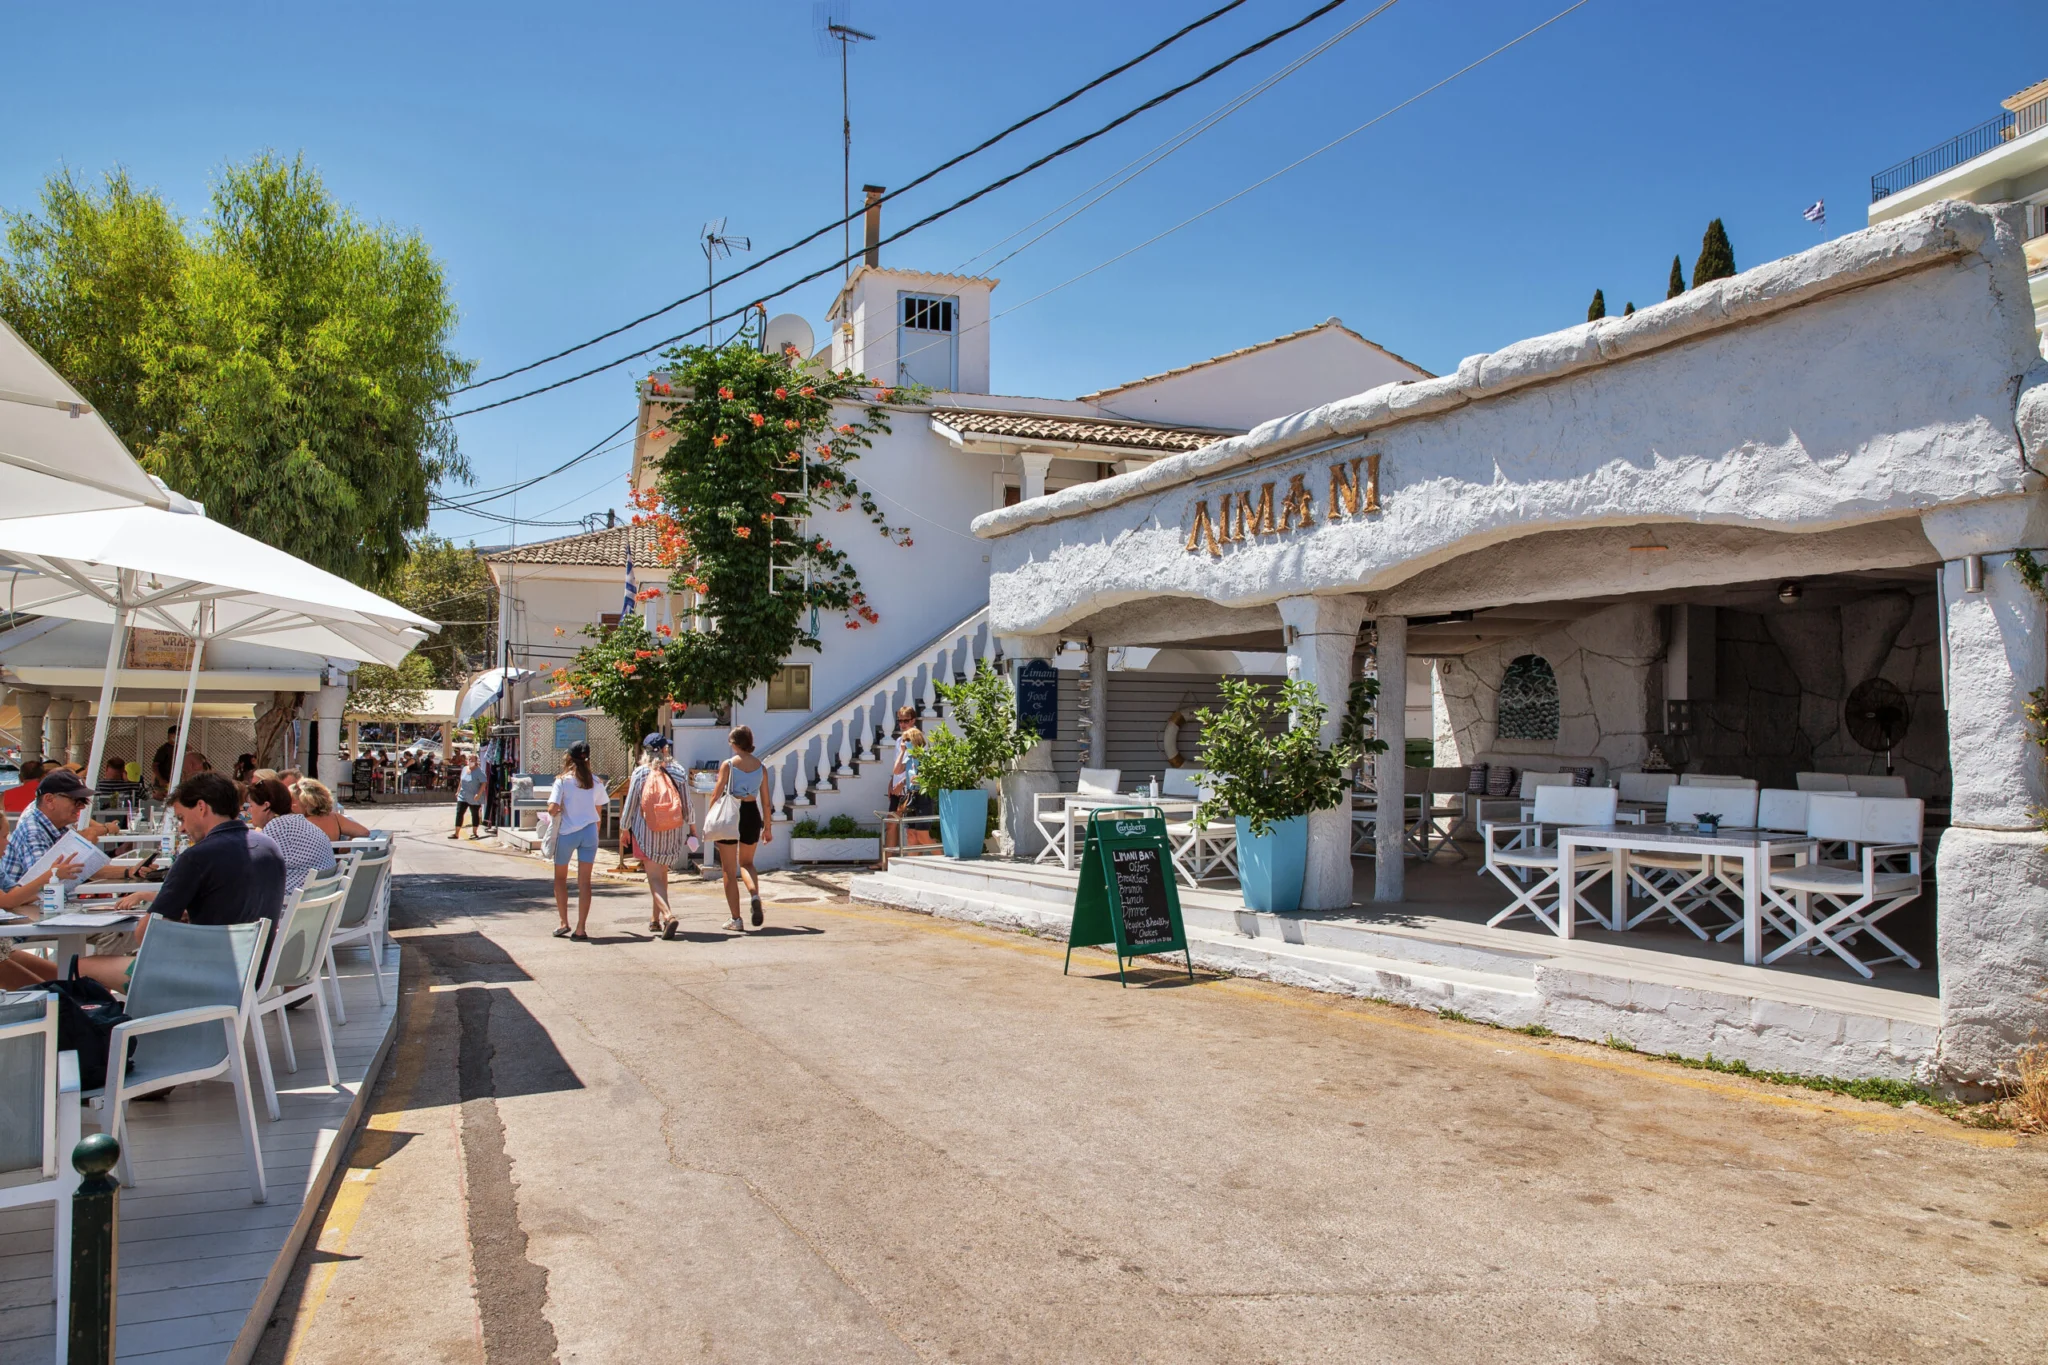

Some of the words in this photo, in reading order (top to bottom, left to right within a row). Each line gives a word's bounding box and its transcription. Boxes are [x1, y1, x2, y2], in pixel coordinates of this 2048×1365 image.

[1021, 667, 1056, 678] Limani
[1027, 691, 1049, 702] Food
[1116, 820, 1147, 836] Carlsberg
[1112, 851, 1137, 862] LIMANI
[1139, 851, 1156, 861] BAR
[1128, 861, 1150, 873] Offers
[1118, 884, 1143, 895] Brunch
[1120, 895, 1144, 905] Lunch
[1121, 905, 1149, 918] Dinner
[1124, 919, 1146, 934] Veggies
